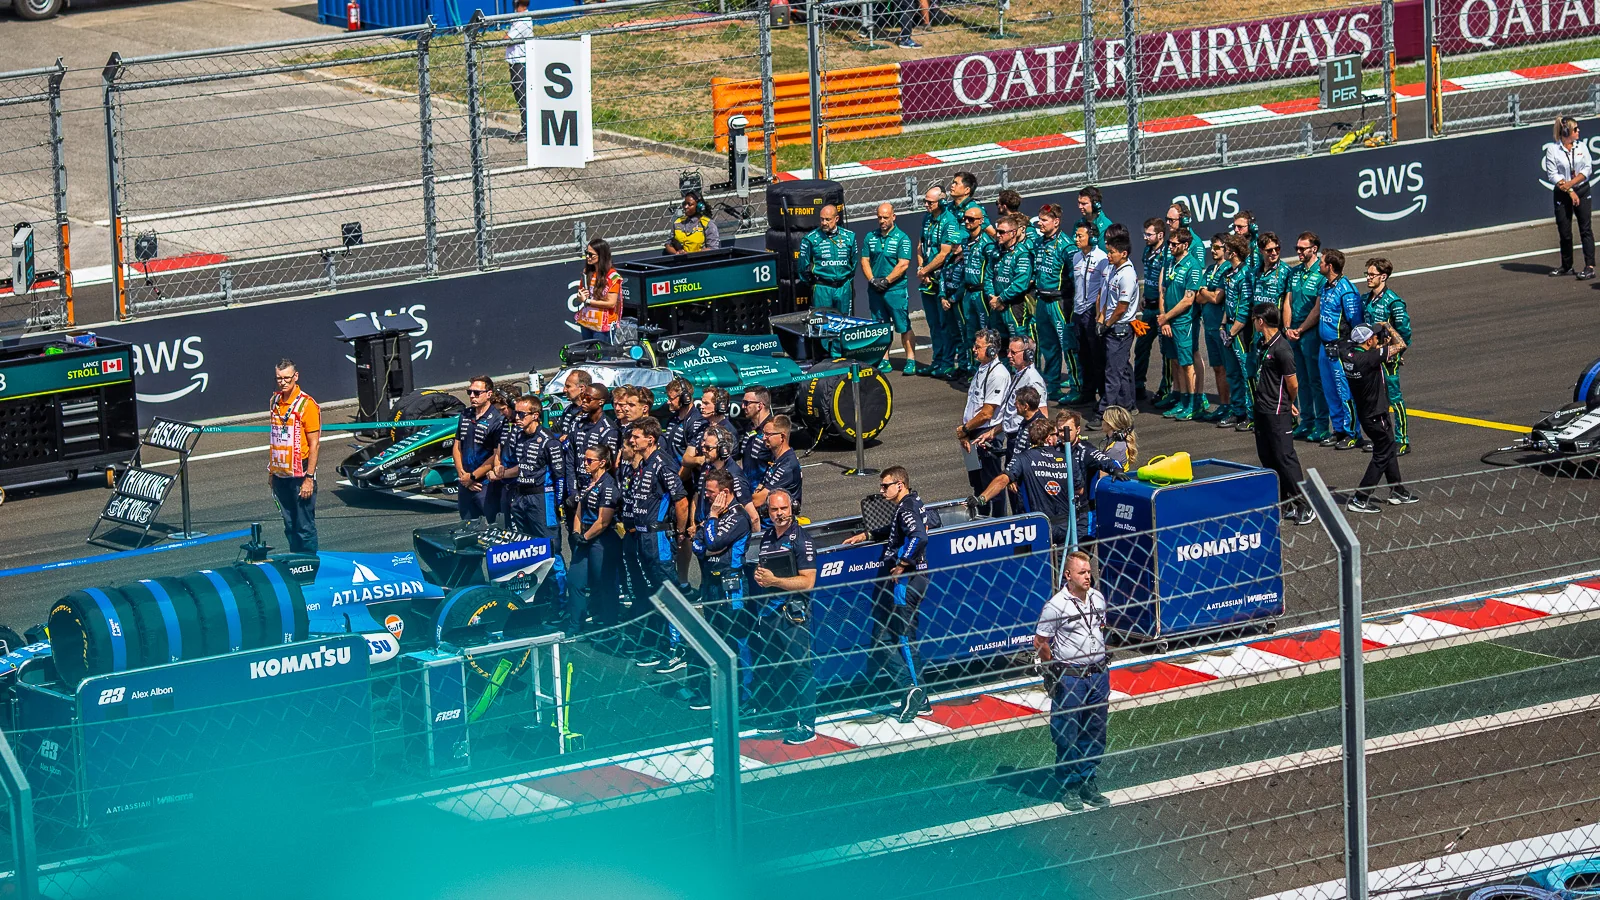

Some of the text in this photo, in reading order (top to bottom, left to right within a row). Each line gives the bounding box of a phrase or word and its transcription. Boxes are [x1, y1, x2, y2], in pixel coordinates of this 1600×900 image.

[1459, 0, 1600, 47] QATA
[953, 13, 1373, 108] QATAR AIRWAYS
[1334, 59, 1356, 82] 11
[544, 62, 573, 99] S
[1332, 86, 1358, 103] PER
[541, 110, 578, 146] M
[1357, 161, 1424, 201] aws
[795, 207, 815, 216] FRONT
[821, 259, 848, 267] aramco
[753, 265, 771, 283] 18
[673, 282, 702, 294] STROLL
[796, 297, 809, 305] EFT
[809, 316, 823, 325] arm
[844, 325, 889, 341] coinbase
[750, 341, 778, 351] cohere
[82, 361, 99, 369] LANCE
[132, 336, 204, 376] aws
[683, 355, 728, 369] MAADEN
[67, 369, 100, 380] STROLL
[740, 368, 779, 378] Honda
[847, 367, 873, 380] PELLI
[150, 421, 193, 450] BISCUIT
[121, 469, 171, 500] THINKING
[117, 498, 131, 518] OF
[1115, 503, 1134, 520] 23
[950, 524, 1037, 555] KOMATSU
[1177, 532, 1261, 562] KOMATSU
[492, 545, 547, 564] KOMATSU
[289, 564, 314, 575] ACELL
[820, 560, 885, 578] 23 Alex Albon
[331, 580, 425, 607] ATLASSIAN
[1212, 592, 1278, 610] ATLASSIAN Williams
[306, 601, 321, 612] ken
[974, 640, 1007, 652] ATLASSIAN
[250, 645, 351, 680] KOMATSU
[98, 686, 174, 706] 23 Alex Albon
[41, 739, 59, 761] 23
[112, 792, 194, 813] ATLASSIAN Williams
